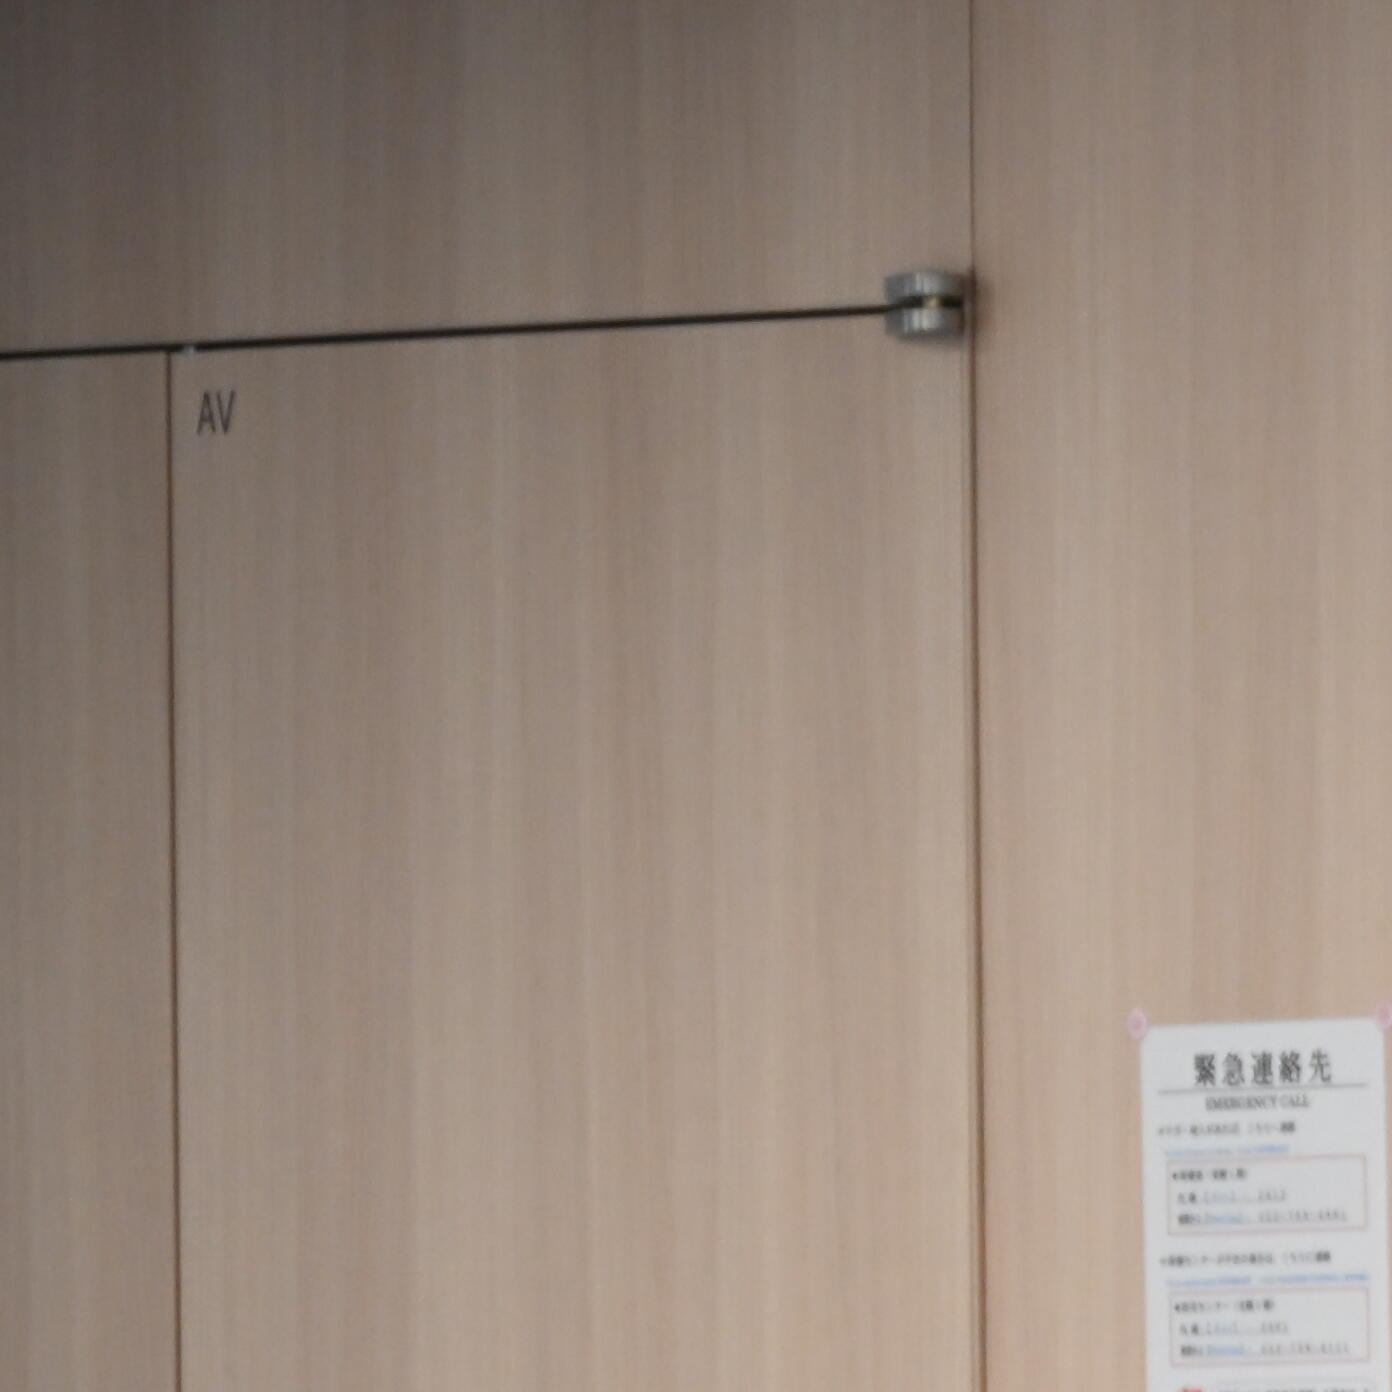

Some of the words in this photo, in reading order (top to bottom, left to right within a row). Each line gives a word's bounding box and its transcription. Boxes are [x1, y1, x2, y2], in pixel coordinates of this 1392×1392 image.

[197, 389, 237, 434] AV
[1194, 1049, 1332, 1087] 緊急連絡先
[1281, 1094, 1310, 1108] CALL
